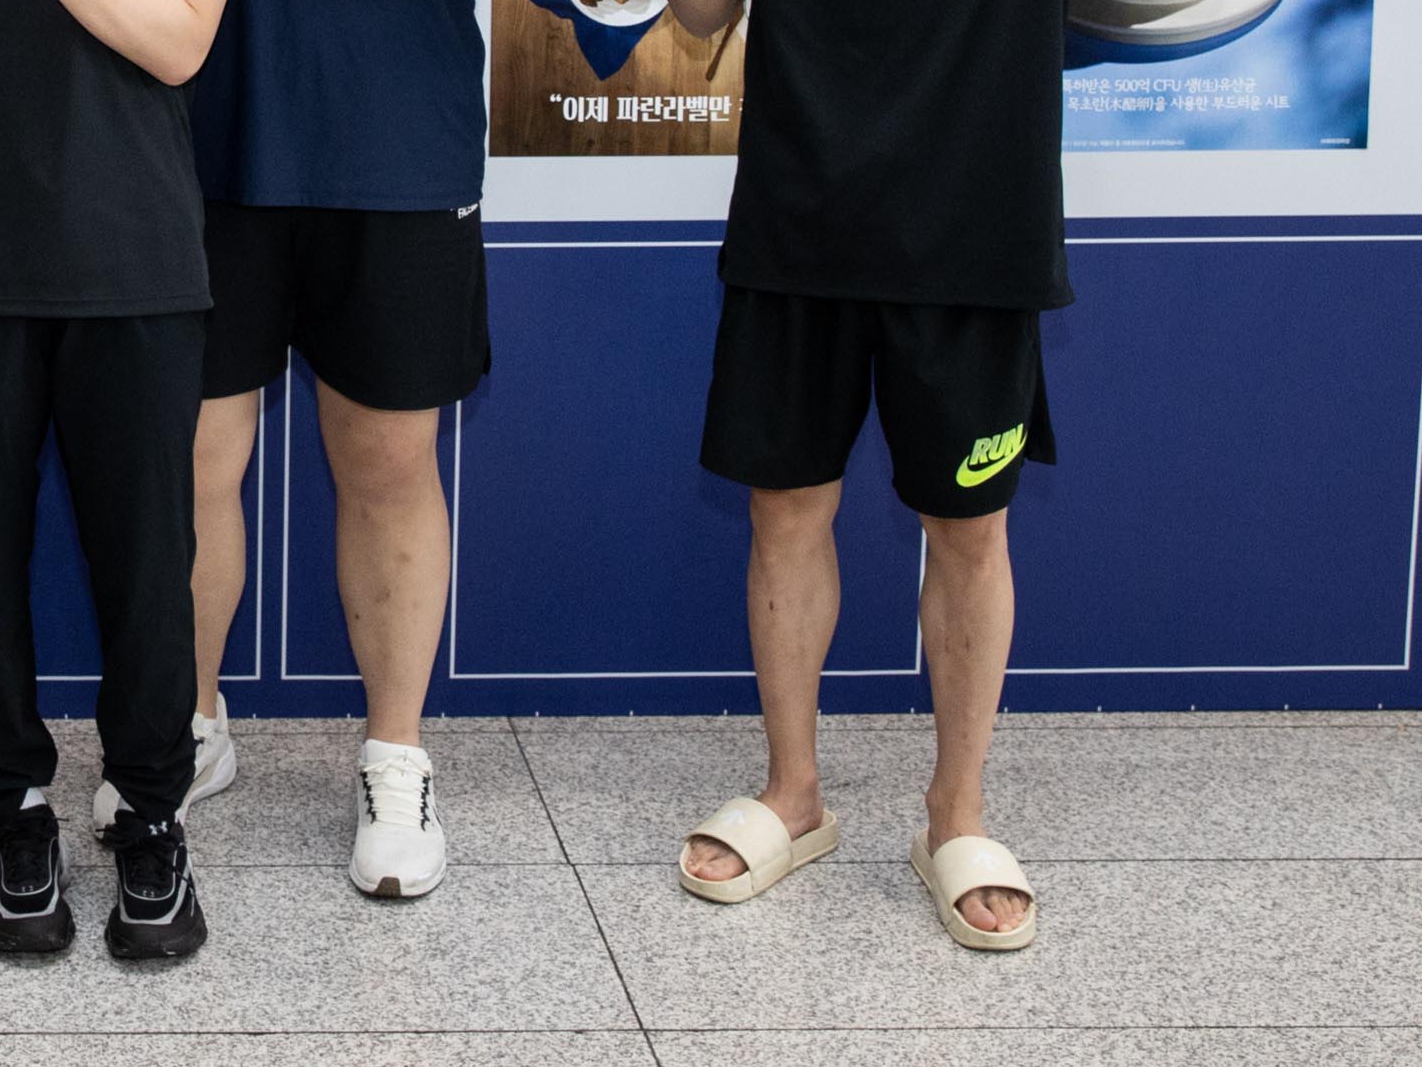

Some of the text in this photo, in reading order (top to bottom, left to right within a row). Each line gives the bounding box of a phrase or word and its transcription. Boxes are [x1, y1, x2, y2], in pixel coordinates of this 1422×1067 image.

[1114, 78, 1150, 94] 500억
[1153, 79, 1182, 92] CFU
[616, 95, 733, 123] 파란라벨만
[1265, 95, 1291, 109] 시트
[969, 422, 1024, 465] RUN
